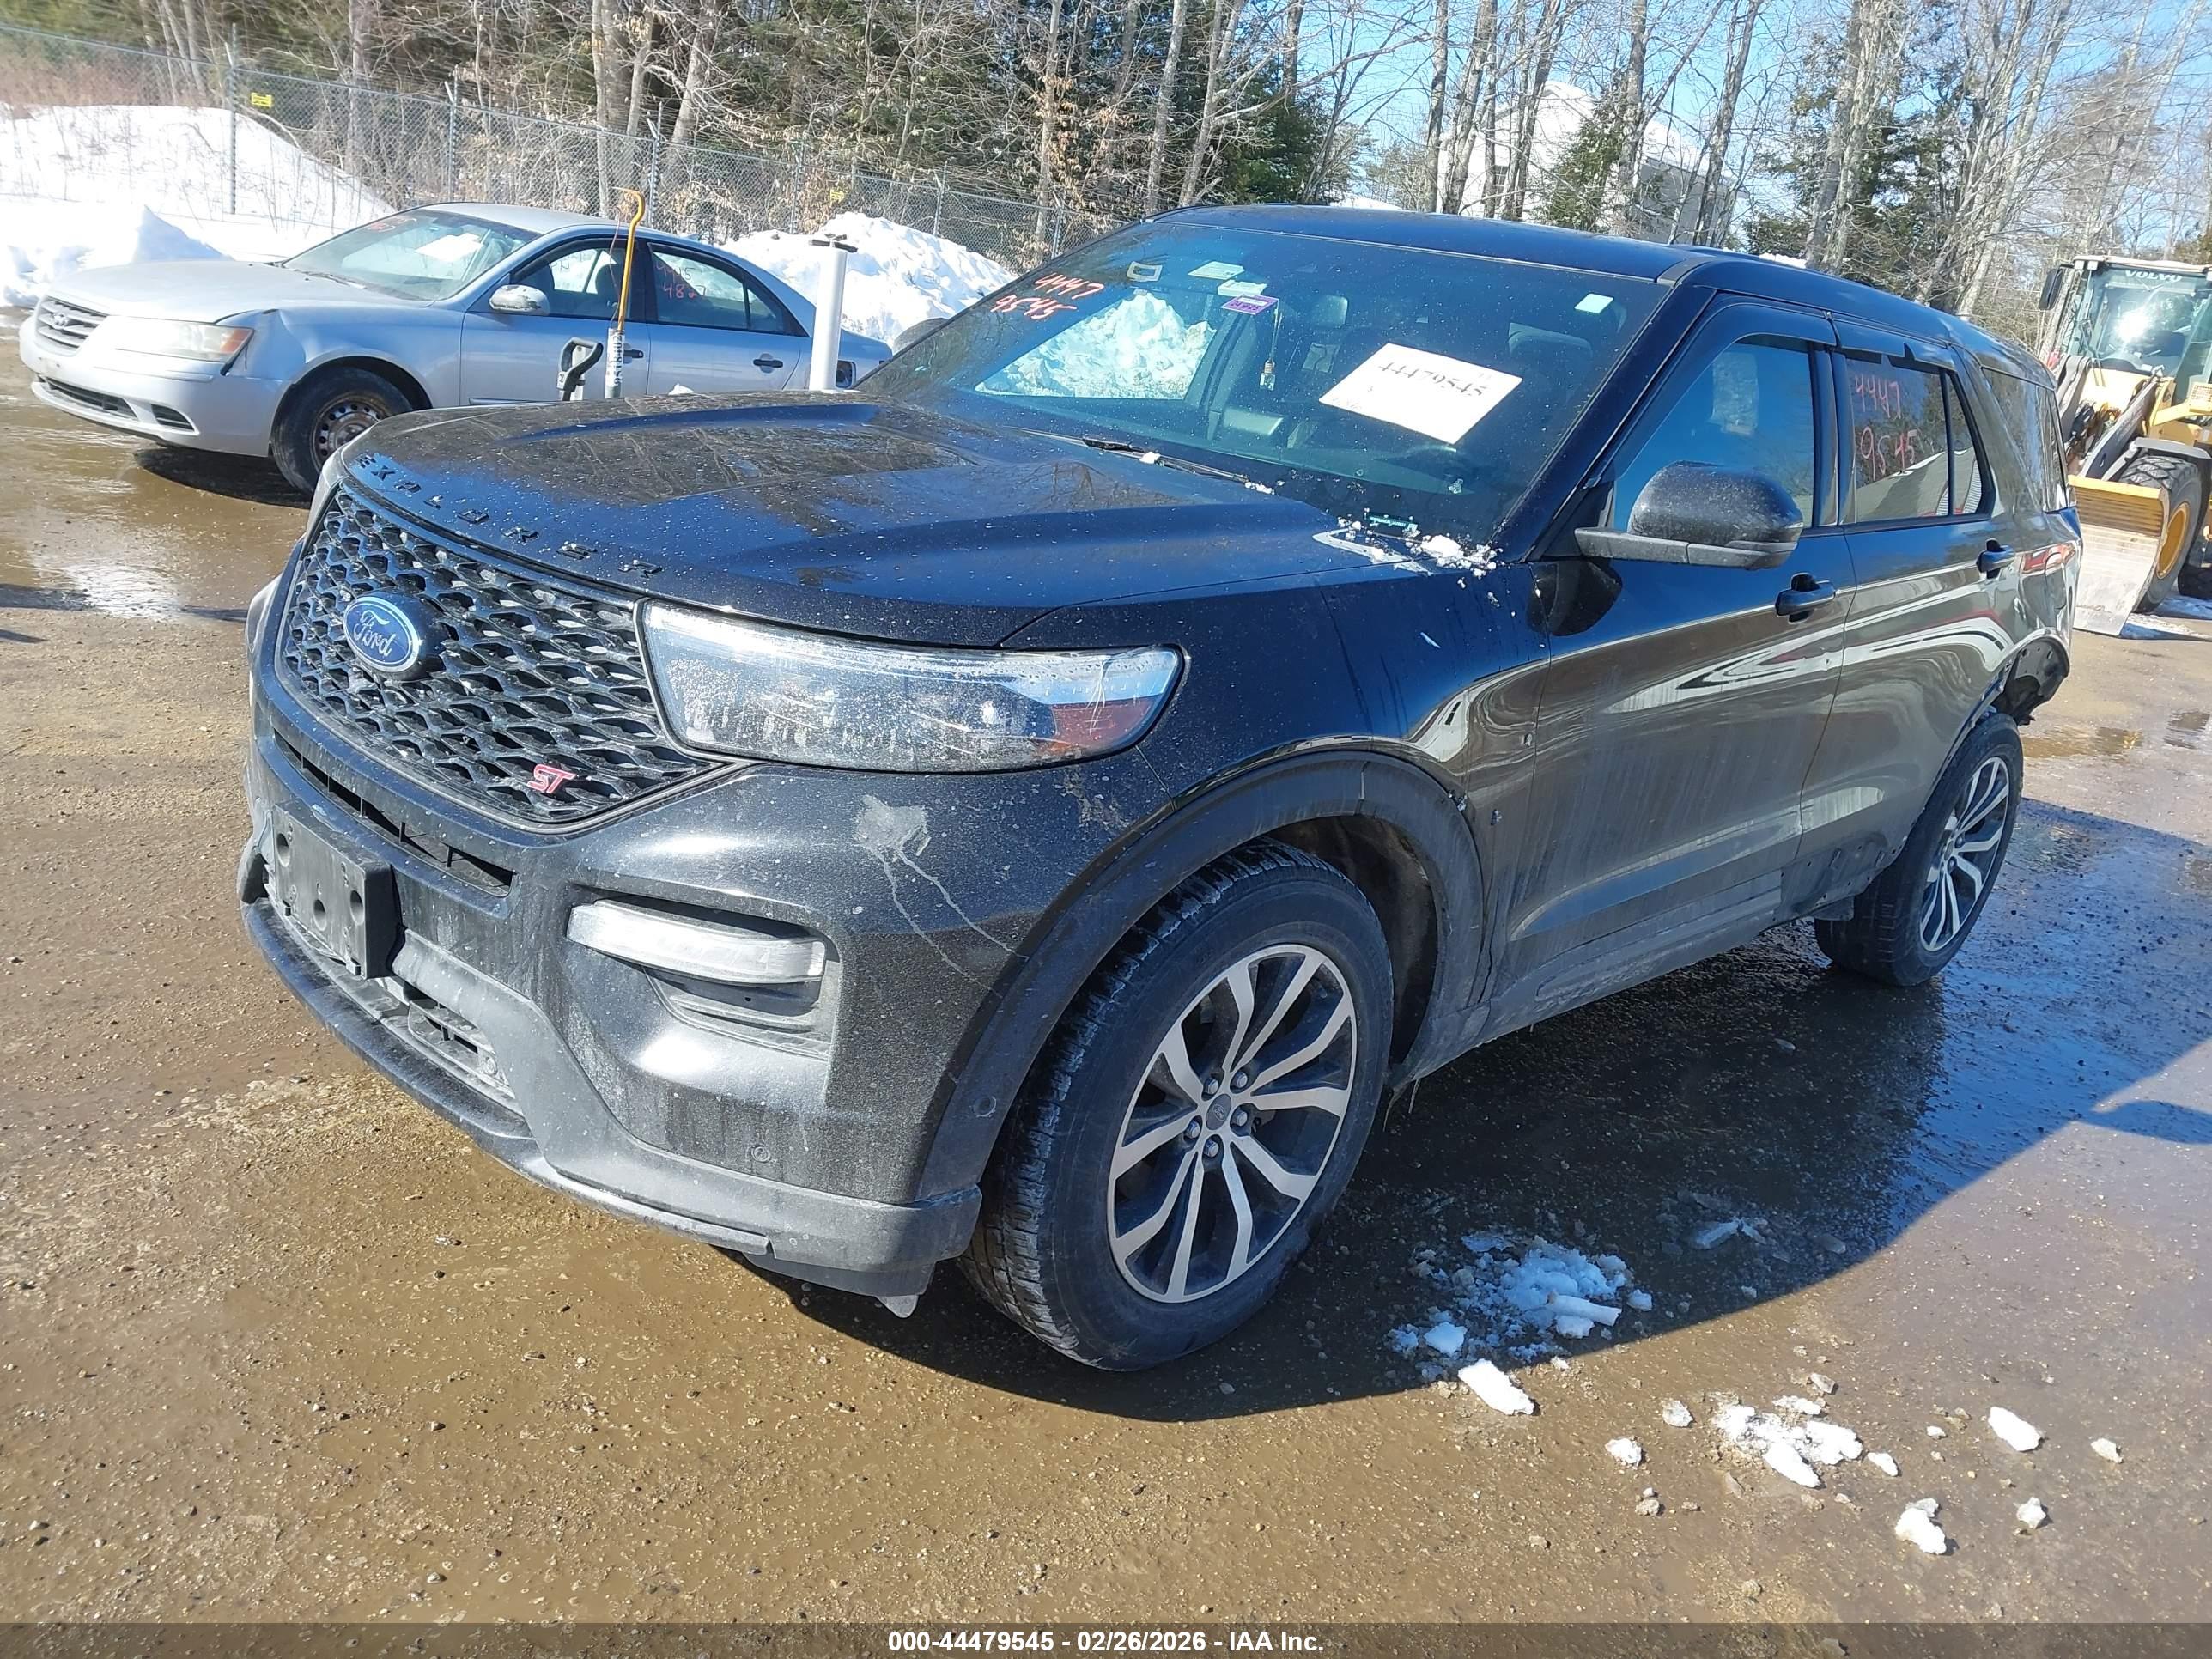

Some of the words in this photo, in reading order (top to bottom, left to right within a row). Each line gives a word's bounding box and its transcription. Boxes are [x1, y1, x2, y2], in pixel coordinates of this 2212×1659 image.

[1034, 272, 1104, 299] 4447
[2125, 270, 2182, 283] VOLVO
[990, 295, 1077, 319] 9545
[1855, 374, 1901, 419] 4447
[354, 609, 397, 657] Ford
[526, 764, 577, 793] ST
